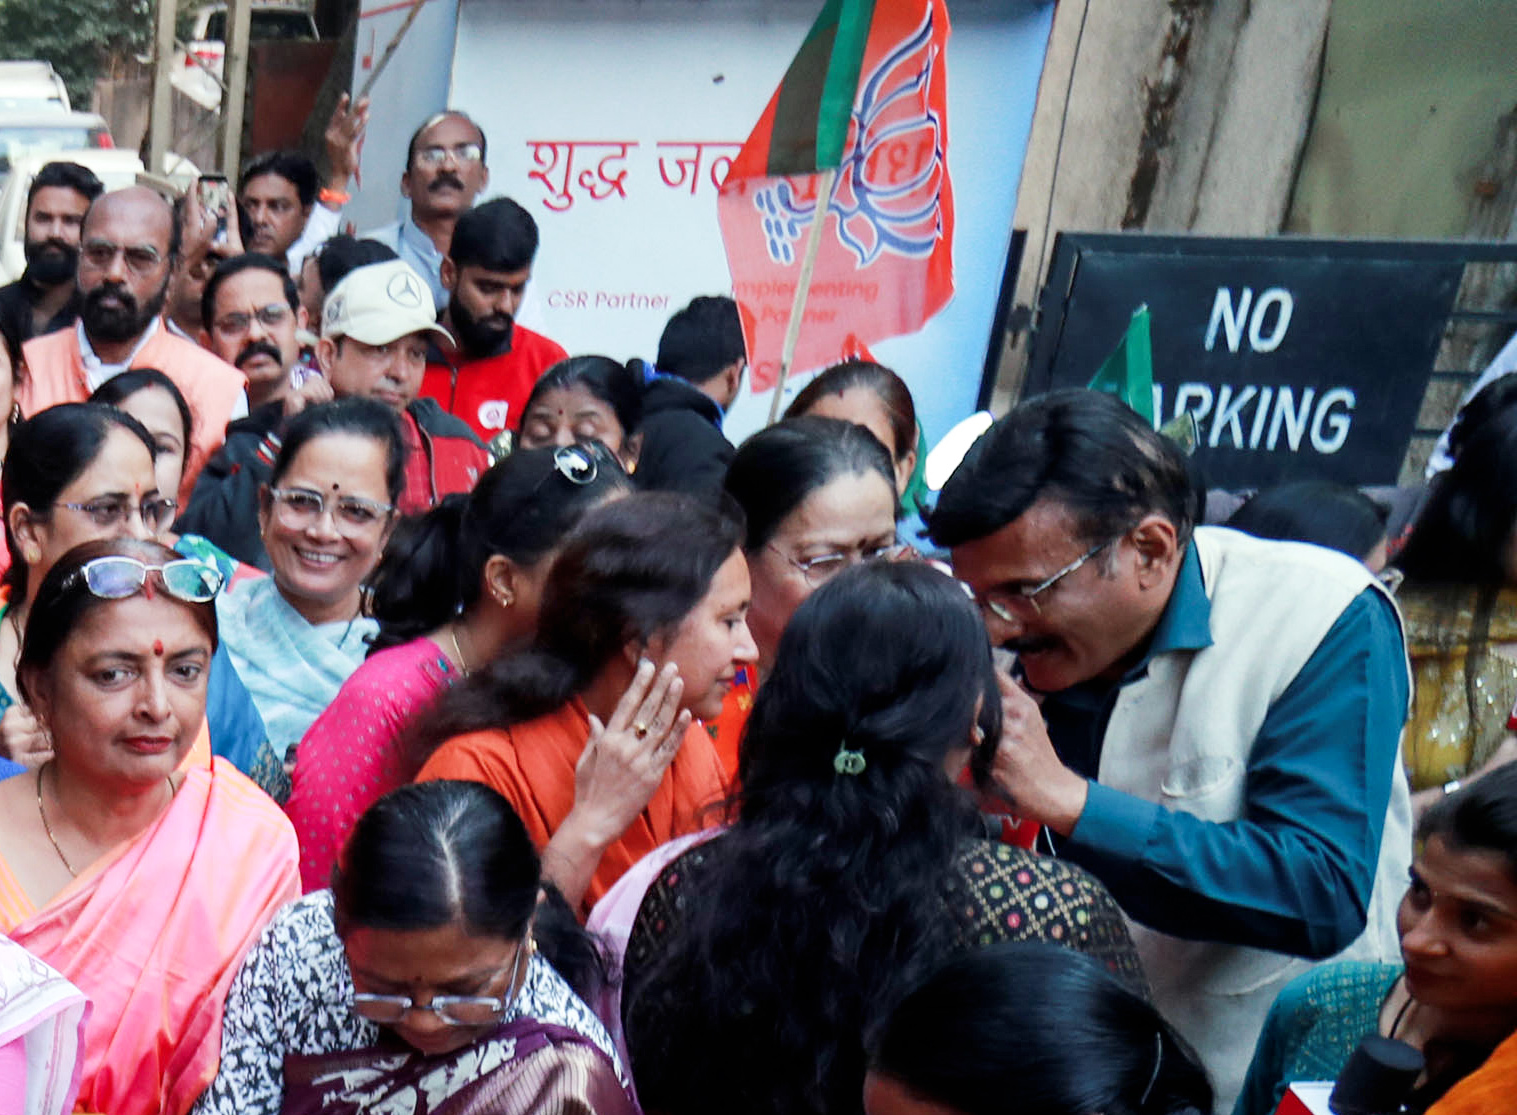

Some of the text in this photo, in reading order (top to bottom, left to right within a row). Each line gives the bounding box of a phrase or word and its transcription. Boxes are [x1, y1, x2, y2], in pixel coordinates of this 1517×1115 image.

[527, 141, 639, 212] शुद्ध
[547, 289, 670, 309] CSR Partner
[1204, 286, 1294, 353] NO
[1153, 382, 1356, 454] RKING
